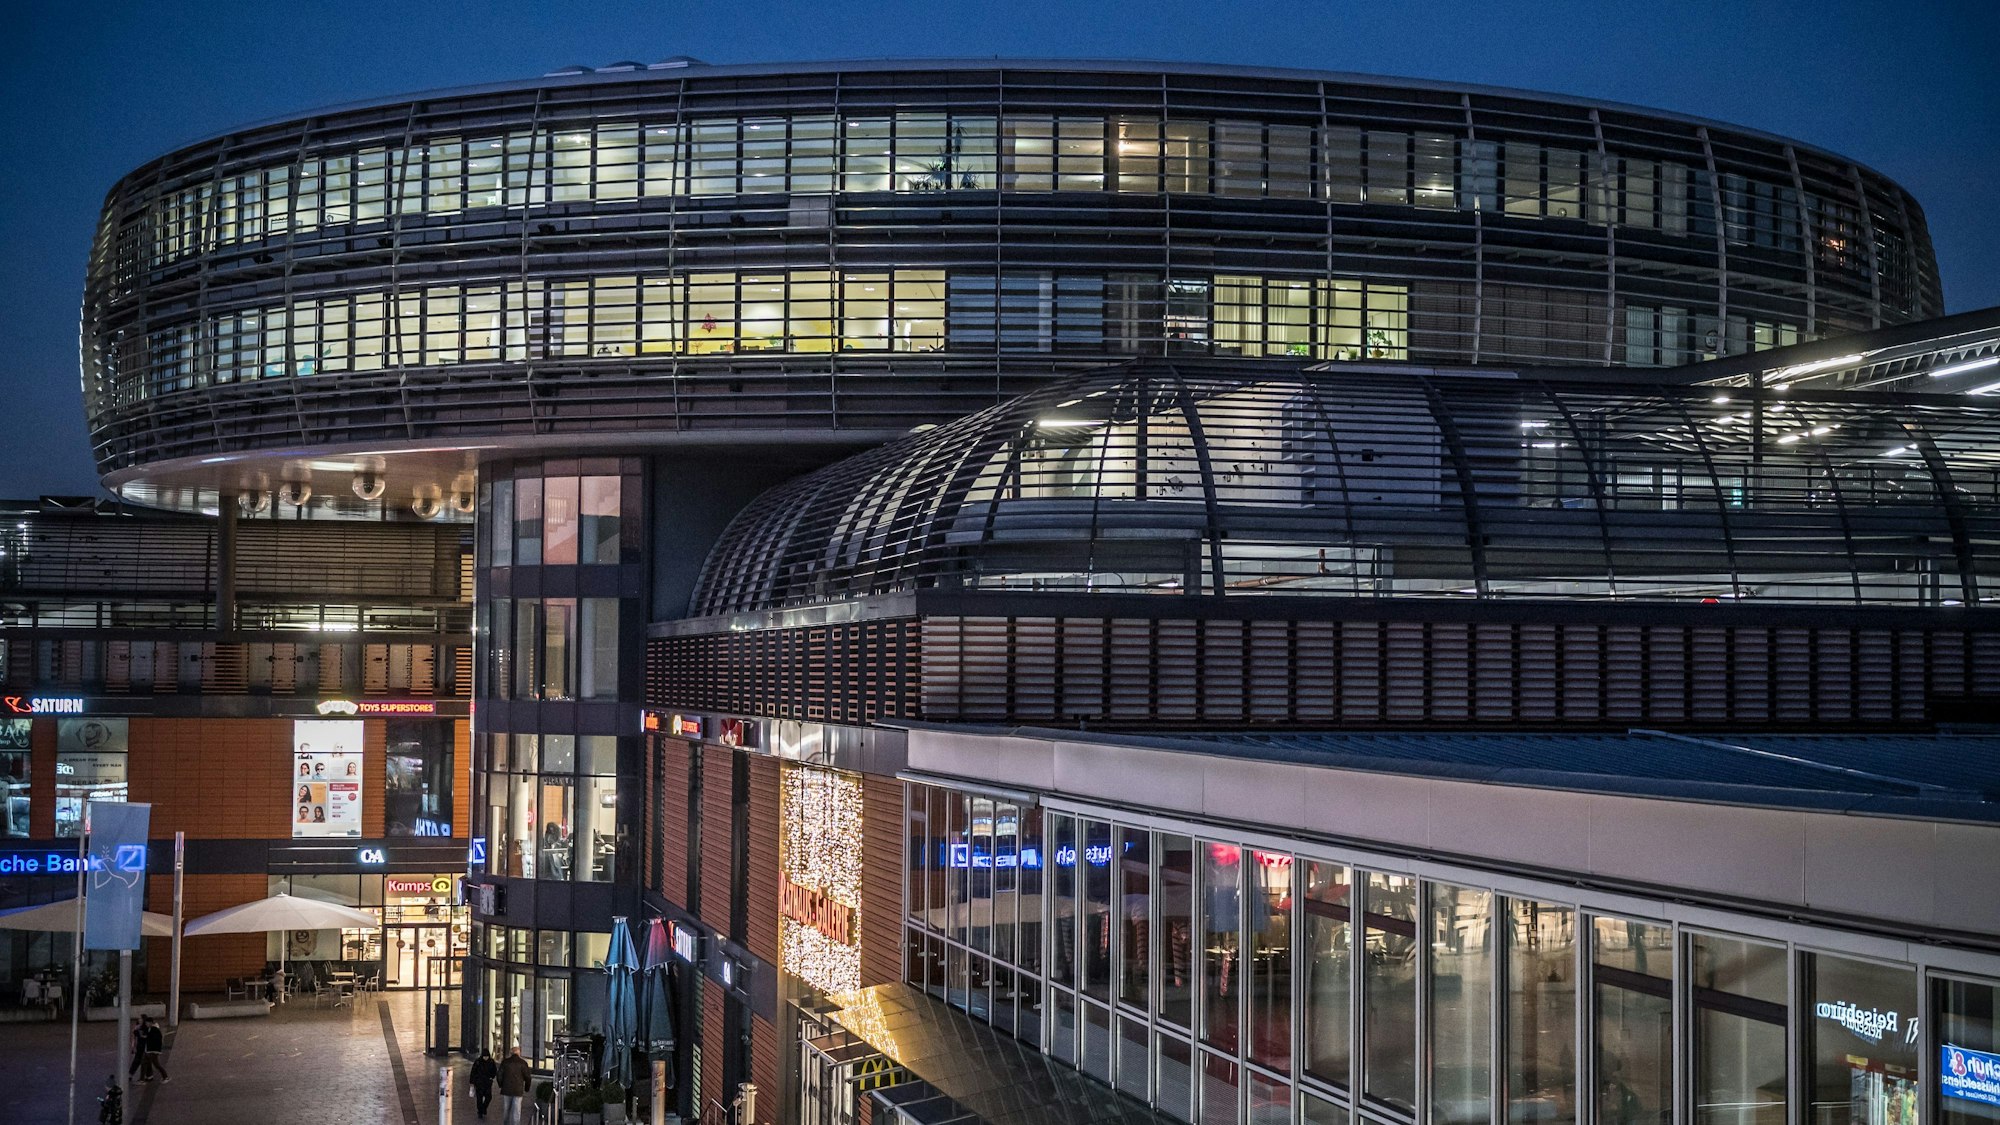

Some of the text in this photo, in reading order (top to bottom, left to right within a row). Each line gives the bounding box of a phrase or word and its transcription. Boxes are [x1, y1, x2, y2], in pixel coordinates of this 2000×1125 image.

[31, 698, 83, 713] SATURN
[360, 704, 433, 712] TOYS SUPERSTORES
[0, 854, 102, 872] che Bank
[388, 880, 432, 893] Kamps
